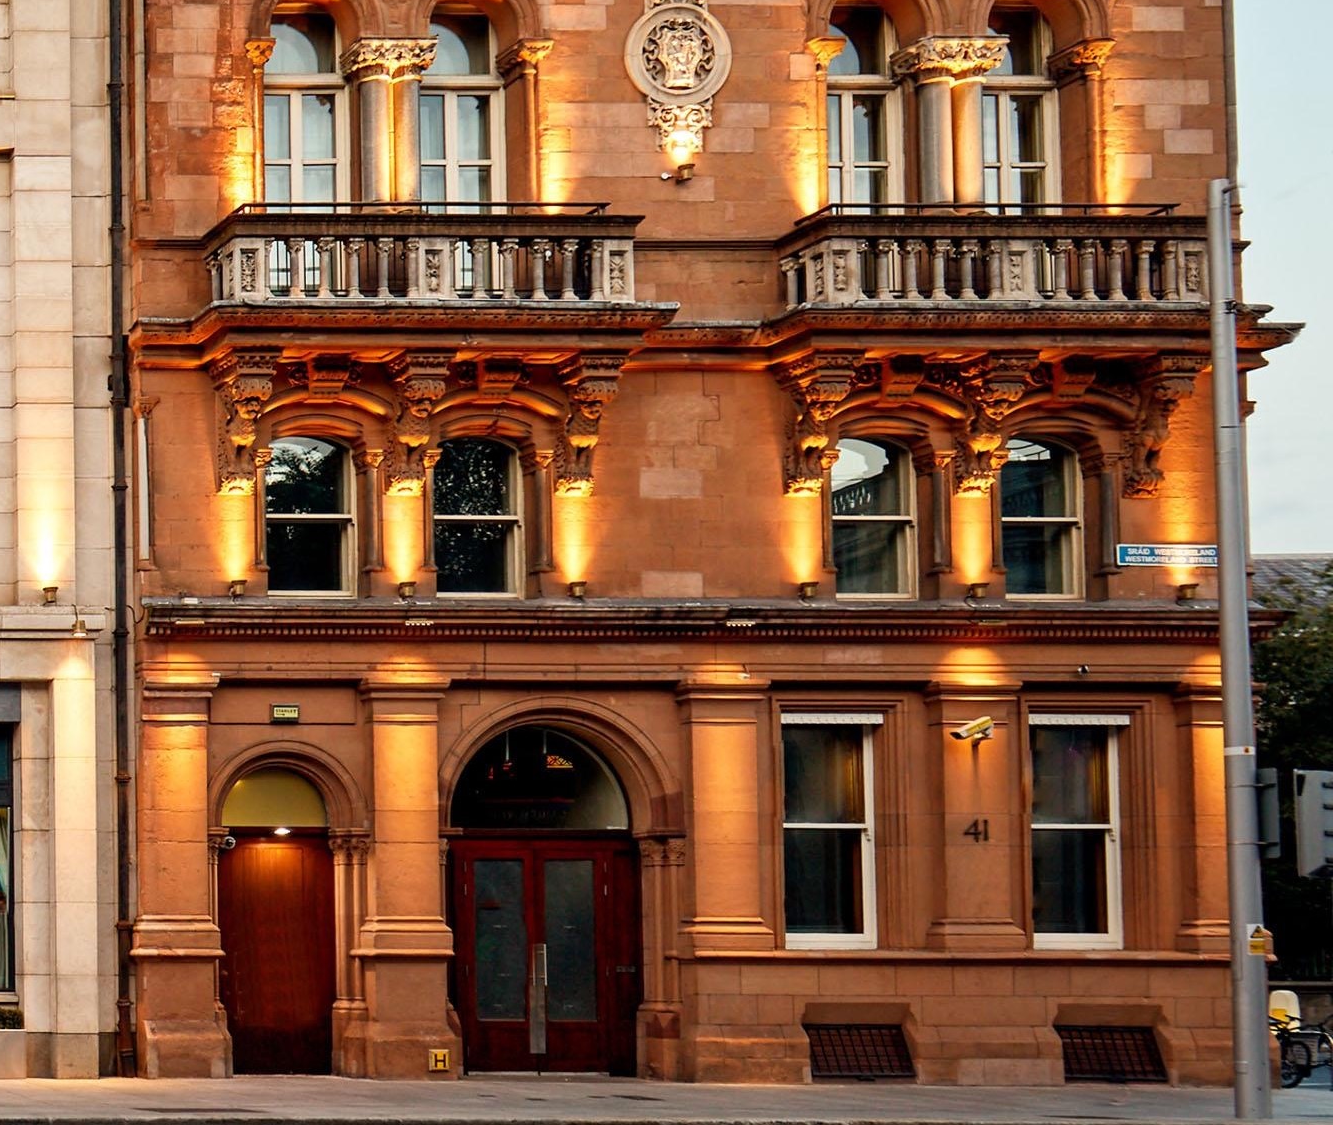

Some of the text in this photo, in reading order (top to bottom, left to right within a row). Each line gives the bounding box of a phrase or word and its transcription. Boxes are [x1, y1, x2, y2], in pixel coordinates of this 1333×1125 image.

[1154, 548, 1216, 556] WESTMORELAND
[963, 819, 990, 843] 41
[434, 1053, 446, 1068] H
